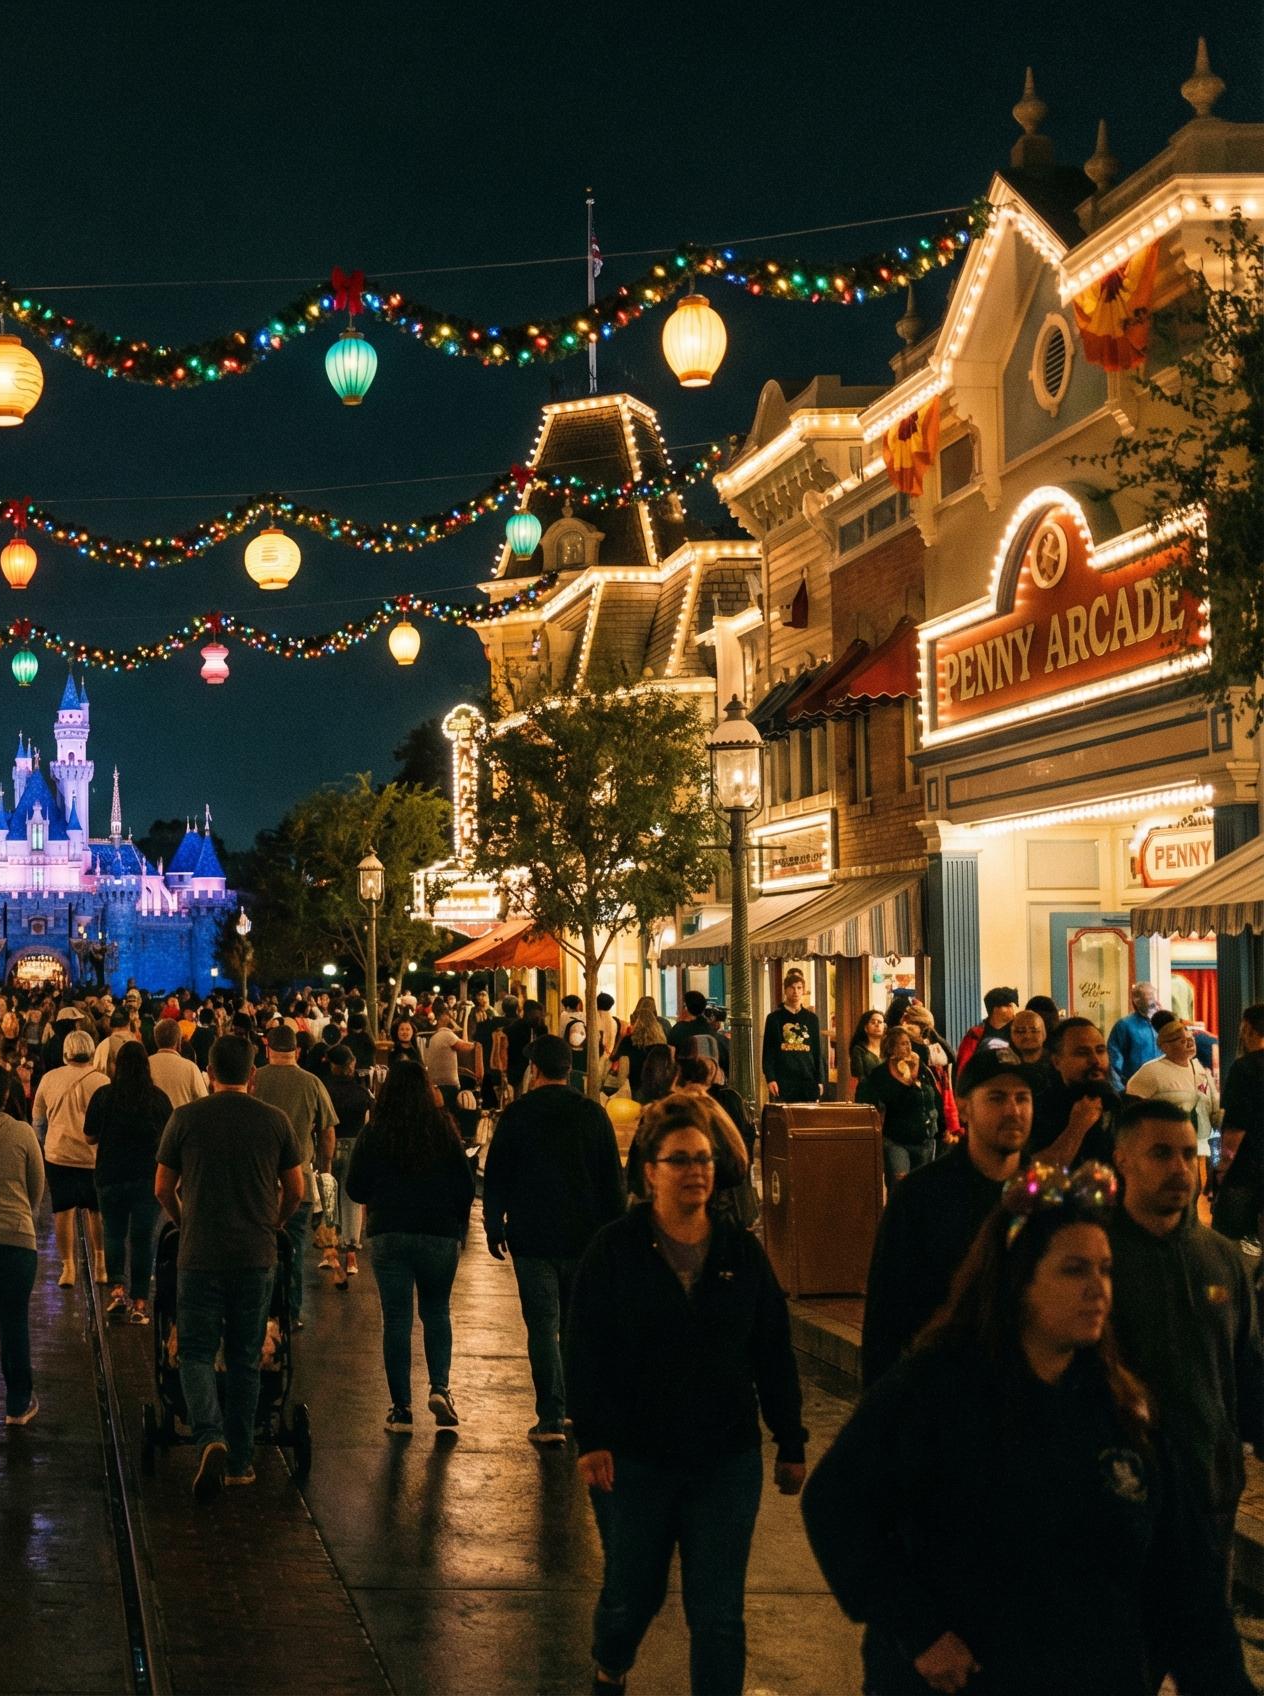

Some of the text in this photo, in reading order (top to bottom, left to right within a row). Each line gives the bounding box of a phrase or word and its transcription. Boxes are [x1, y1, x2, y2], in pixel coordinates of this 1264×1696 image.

[944, 573, 1185, 704] PENNY ARCADE
[1155, 840, 1212, 870] PENNY
